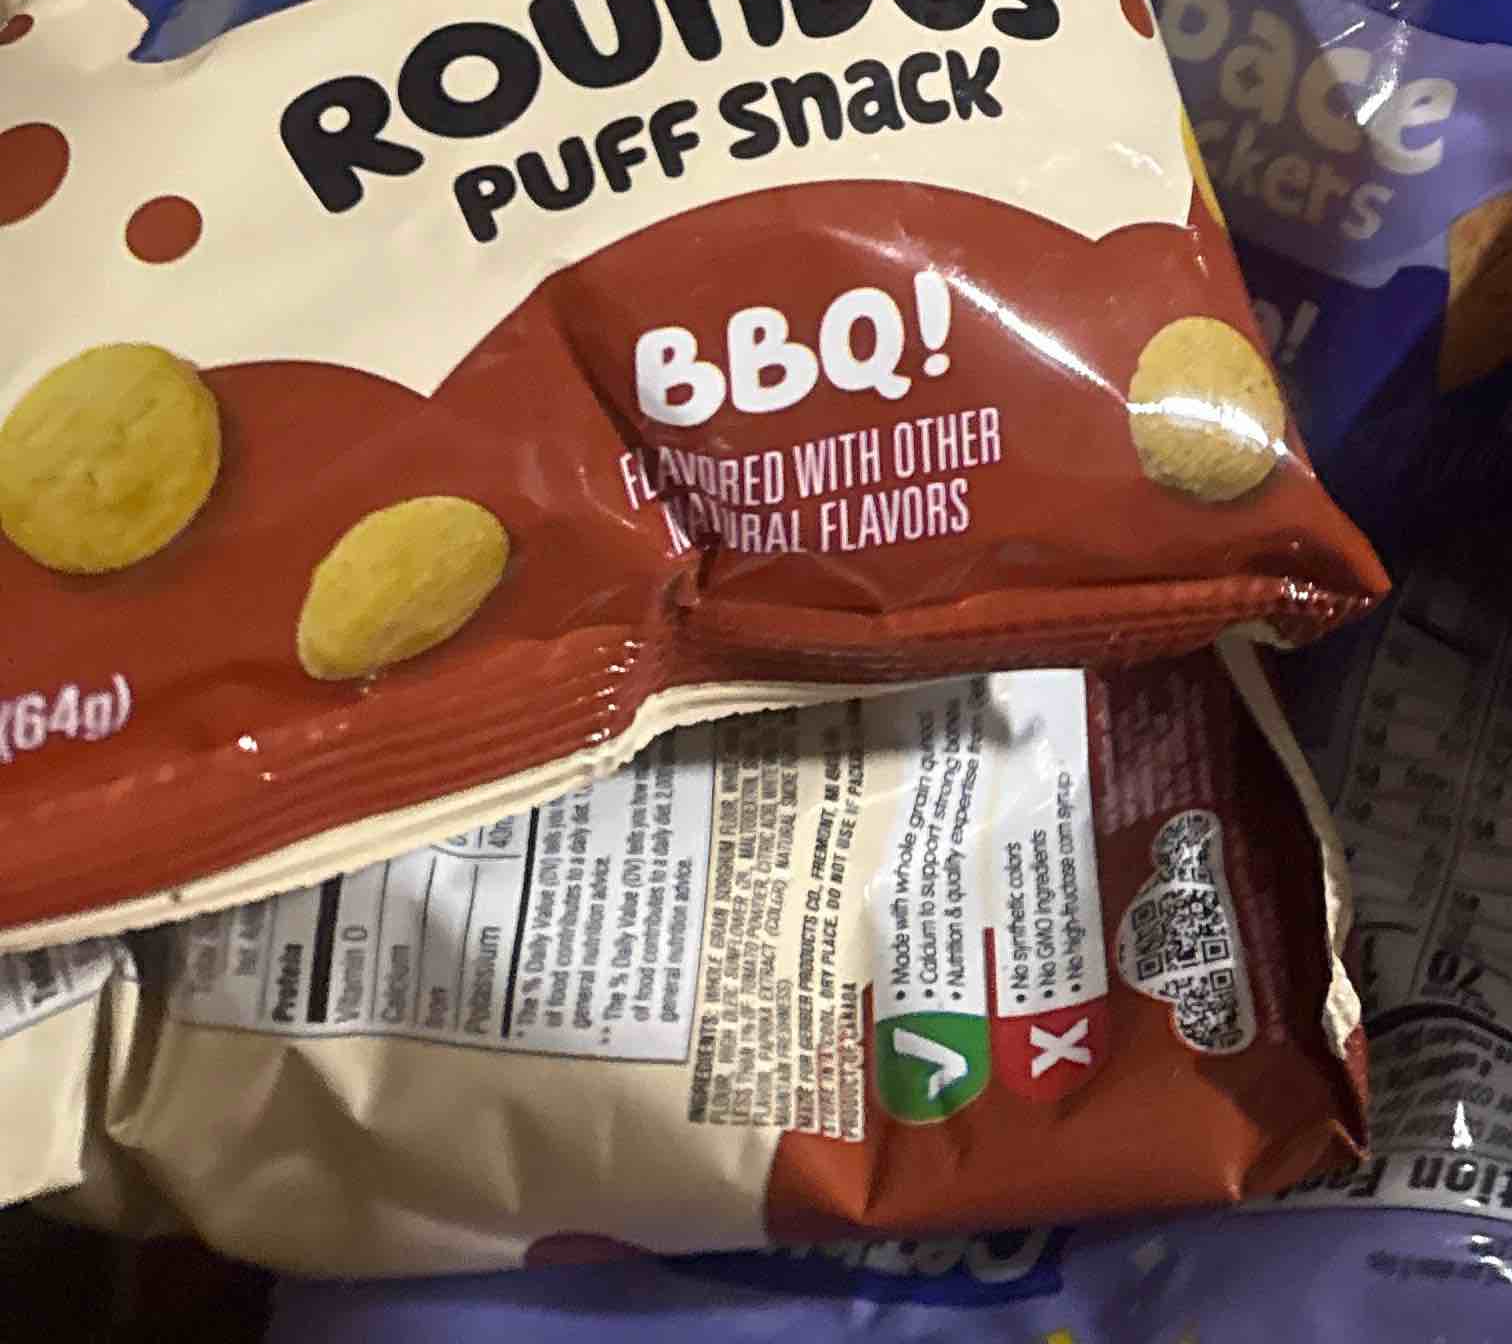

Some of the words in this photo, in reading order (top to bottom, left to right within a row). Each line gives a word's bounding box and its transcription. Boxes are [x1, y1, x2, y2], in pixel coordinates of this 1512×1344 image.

[454, 99, 700, 243] PUFF
[634, 270, 953, 428] BBQ!
[791, 432, 883, 490] WITH
[892, 406, 1003, 474] OTHER
[817, 479, 971, 554] FLAVORS
[893, 831, 918, 893] whole
[906, 776, 932, 828] grain
[920, 822, 941, 897] support
[932, 758, 959, 820] strong
[950, 758, 979, 846] expertise
[1002, 840, 1023, 888] colors
[1030, 828, 1055, 914] ingredients
[616, 890, 640, 927] Value
[1034, 918, 1052, 959] GMO
